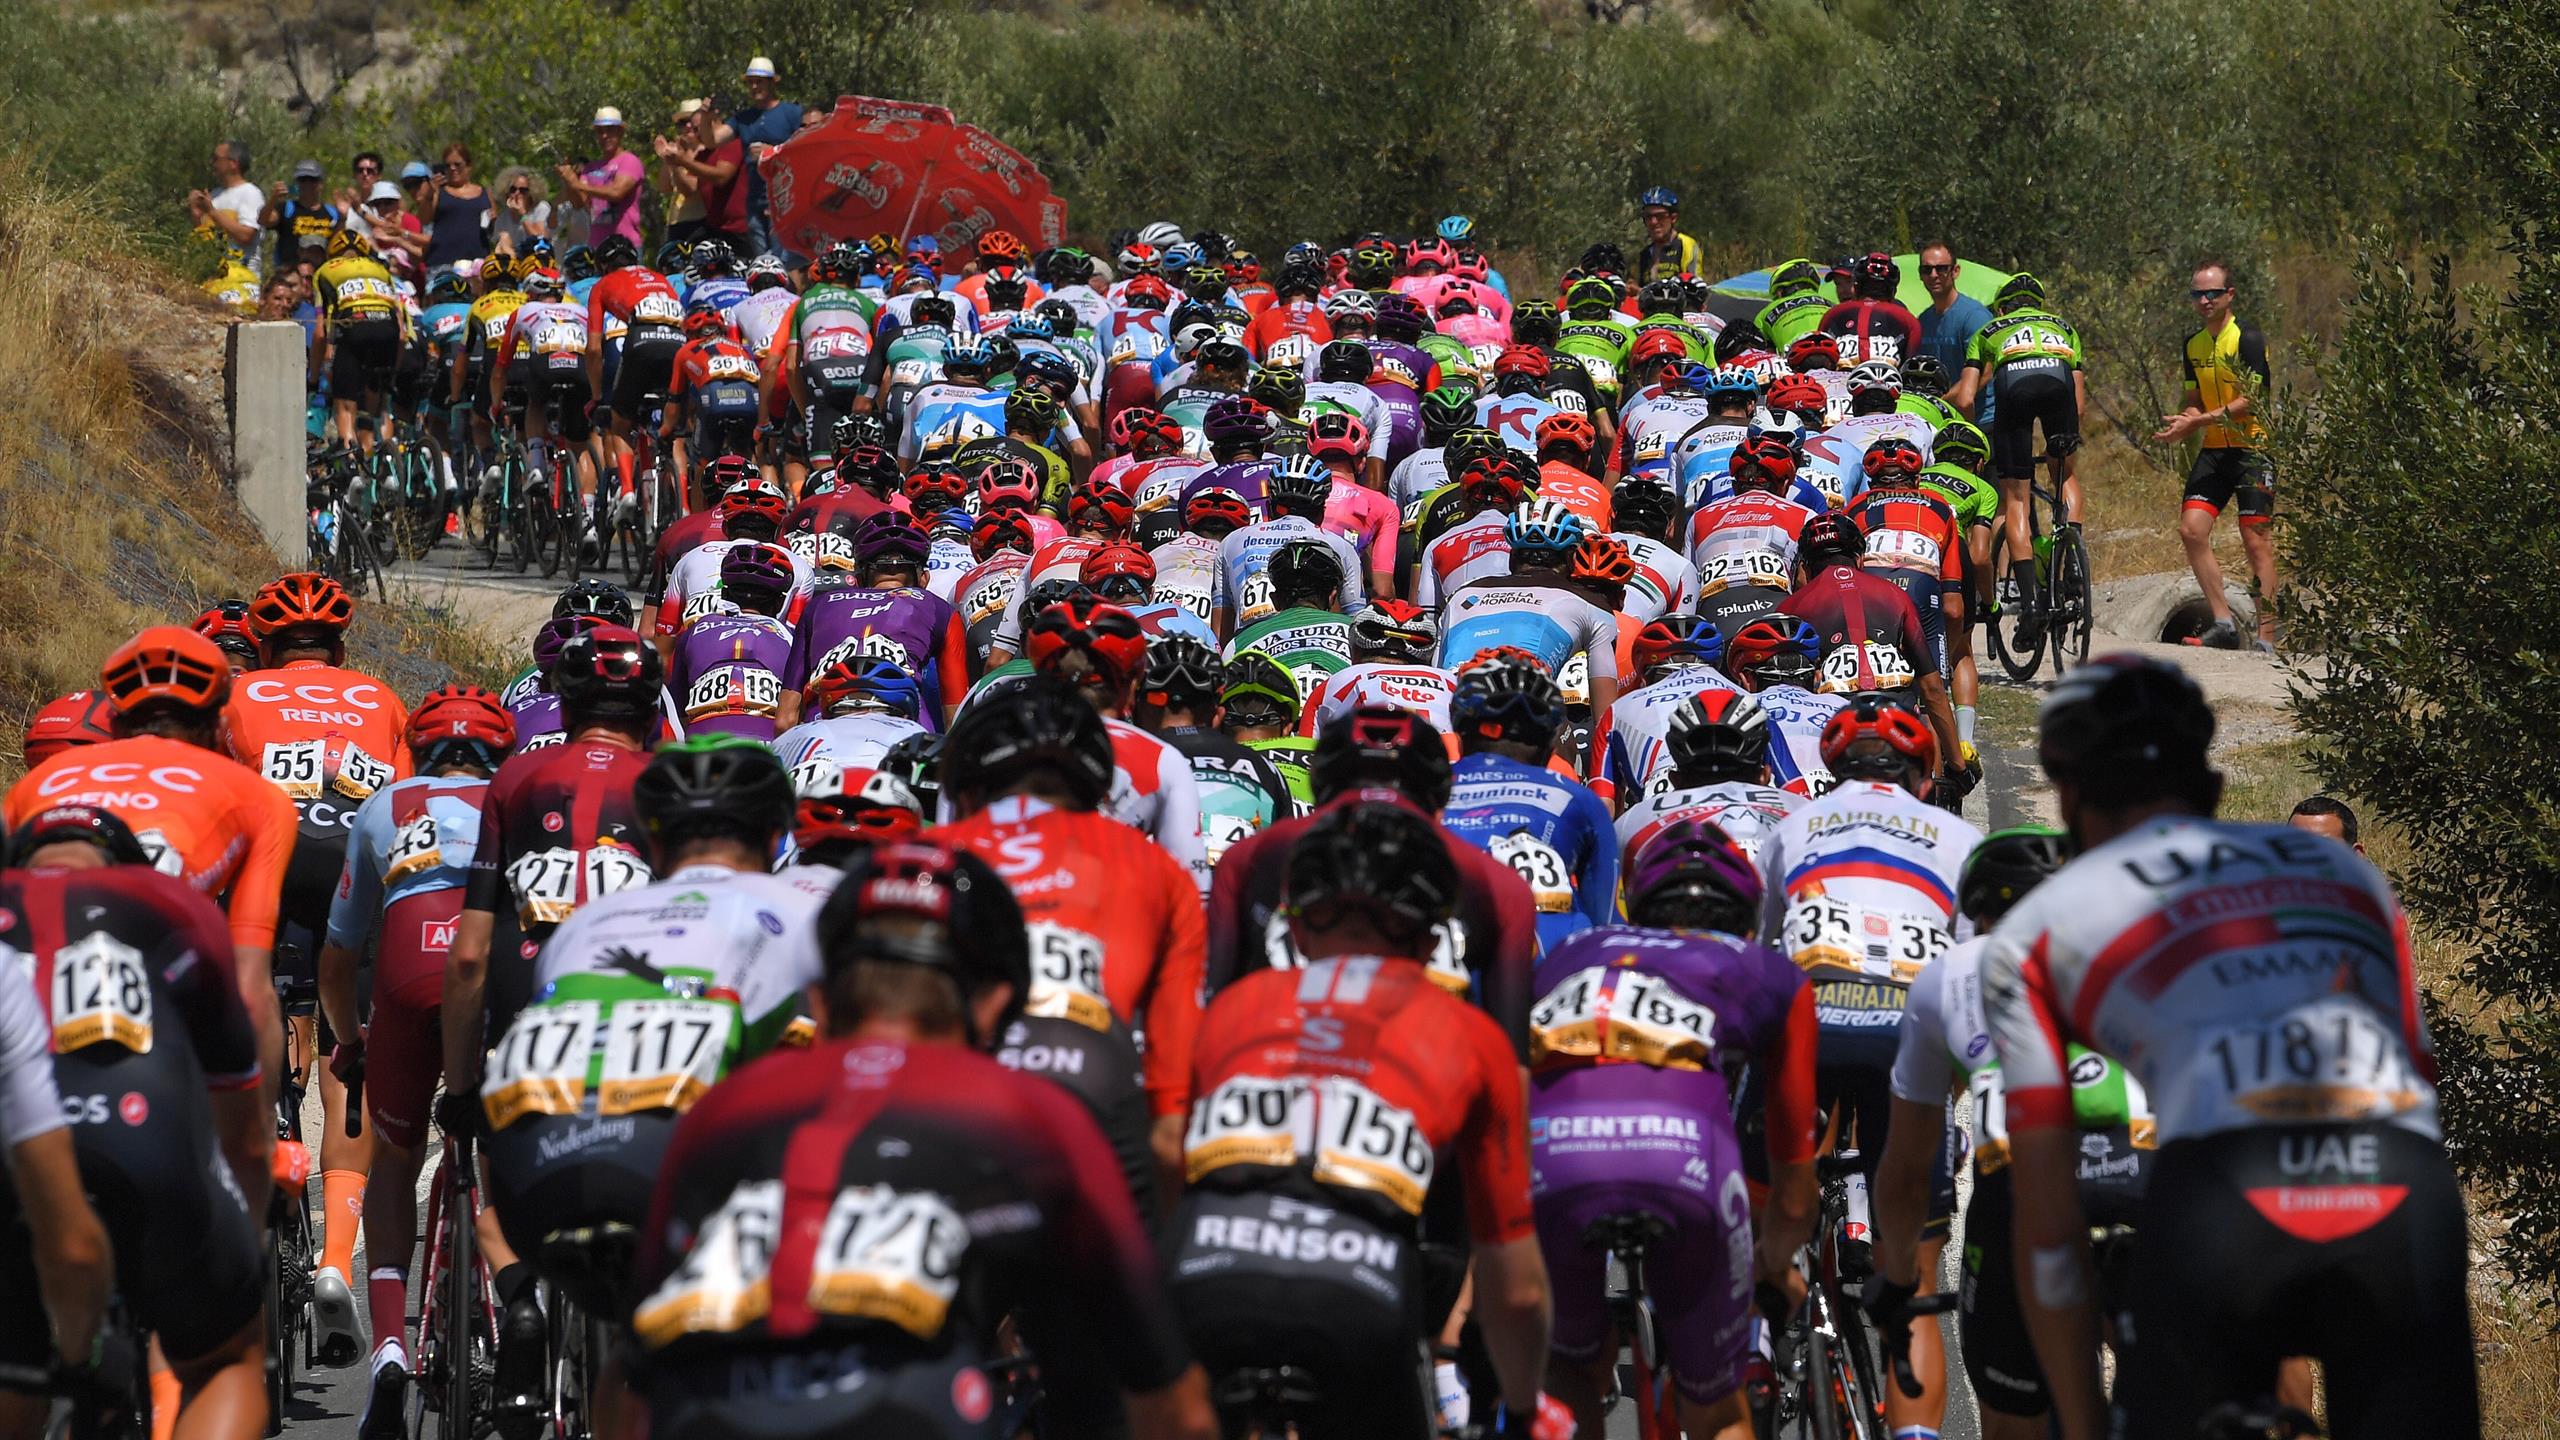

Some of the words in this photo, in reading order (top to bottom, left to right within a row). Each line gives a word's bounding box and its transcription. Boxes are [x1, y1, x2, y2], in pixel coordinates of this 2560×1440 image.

[340, 280, 365, 296] 133
[804, 293, 862, 309] BORA
[1768, 296, 1834, 323] ELKAN
[903, 324, 946, 336] BOR
[1985, 316, 2070, 330] ELKANO
[1559, 326, 1623, 347] LKANO
[1637, 324, 1707, 344] LKANO
[809, 340, 829, 356] 45
[1272, 343, 1295, 357] 151
[1659, 344, 1668, 352] K
[1838, 340, 1857, 356] 22
[713, 360, 732, 369] 36
[823, 366, 866, 379] BORA
[899, 362, 920, 375] 44
[1178, 388, 1240, 400] BORA
[1554, 395, 1585, 412] 106
[1795, 400, 1803, 408] K
[1386, 402, 1413, 412] TRAL
[1652, 403, 1679, 412] FDJ
[938, 422, 948, 436] 4
[972, 424, 983, 436] 4
[1639, 434, 1662, 451] 84
[1703, 436, 1747, 445] MONDIA
[1538, 482, 1600, 502] CC
[1808, 473, 1841, 494] 146
[1922, 473, 1970, 494] ANO
[1707, 495, 1790, 512] TREK
[1867, 497, 1931, 510] MERIDA
[1712, 510, 1773, 529] Segafredo
[1152, 527, 1180, 539] splu
[1243, 535, 1289, 548] deceun
[1443, 527, 1504, 547] TRE
[791, 539, 815, 556] 23
[1463, 538, 1512, 561] Segafre
[1912, 537, 1936, 559] 37
[928, 559, 950, 570] DJ
[1115, 562, 1124, 571] K
[1702, 560, 1728, 584] 62
[1747, 558, 1787, 579] 162
[815, 575, 841, 585] EOS
[968, 582, 1001, 612] 165
[1245, 582, 1268, 607] 67
[1479, 598, 1543, 606] MONDIALE
[1483, 592, 1515, 600] AG2R
[851, 601, 894, 618] BH
[718, 627, 762, 641] BH
[1253, 634, 1283, 651] AJA
[1290, 624, 1350, 639] RURA
[1267, 640, 1300, 656] UROS
[1306, 638, 1350, 661] RGA
[1828, 652, 1857, 679] 25
[1870, 651, 1914, 674] 125
[1368, 674, 1445, 691] SOUDAL
[1566, 663, 1583, 687] 5
[246, 680, 381, 710] CCC
[690, 674, 730, 707] 188
[1759, 692, 1841, 713] roupama
[278, 708, 365, 727] RENO
[1765, 707, 1801, 723] DJ
[453, 720, 468, 735] K
[272, 749, 314, 780] 55
[350, 753, 386, 791] 55
[1190, 756, 1261, 783] RA
[37, 763, 202, 797] CCC
[1194, 770, 1255, 791] grohe
[1458, 772, 1503, 782] MAES
[57, 792, 158, 810] RENO
[1449, 786, 1549, 801] ceuninck
[1653, 789, 1779, 812] UAE
[1440, 814, 1484, 825] UICK
[1488, 813, 1531, 824] STEP
[1807, 811, 1939, 839] BAHRAIN
[1806, 822, 1938, 849] MERIDA
[1509, 850, 1560, 887] 63
[2124, 835, 2329, 887] UAE
[510, 857, 575, 898] 127
[1800, 904, 1850, 943] 35
[1902, 925, 1948, 960] 35
[1043, 933, 1101, 994] 58
[57, 956, 148, 1015] 128
[1629, 984, 1703, 1034] 184
[1814, 1008, 1904, 1026] MERIDA
[502, 1021, 581, 1079] 117
[628, 1020, 712, 1075] 117
[2212, 1021, 2319, 1092] 178
[997, 1047, 1085, 1073] SON
[1341, 1095, 1426, 1175] 156
[1549, 1115, 1701, 1140] CENTRAL
[536, 1117, 635, 1165] Nederburg
[2278, 1134, 2380, 1173] UAE
[2076, 1153, 2140, 1181] derburg
[2278, 1191, 2380, 1211] Emirates
[1193, 1214, 1399, 1270] RENSON
